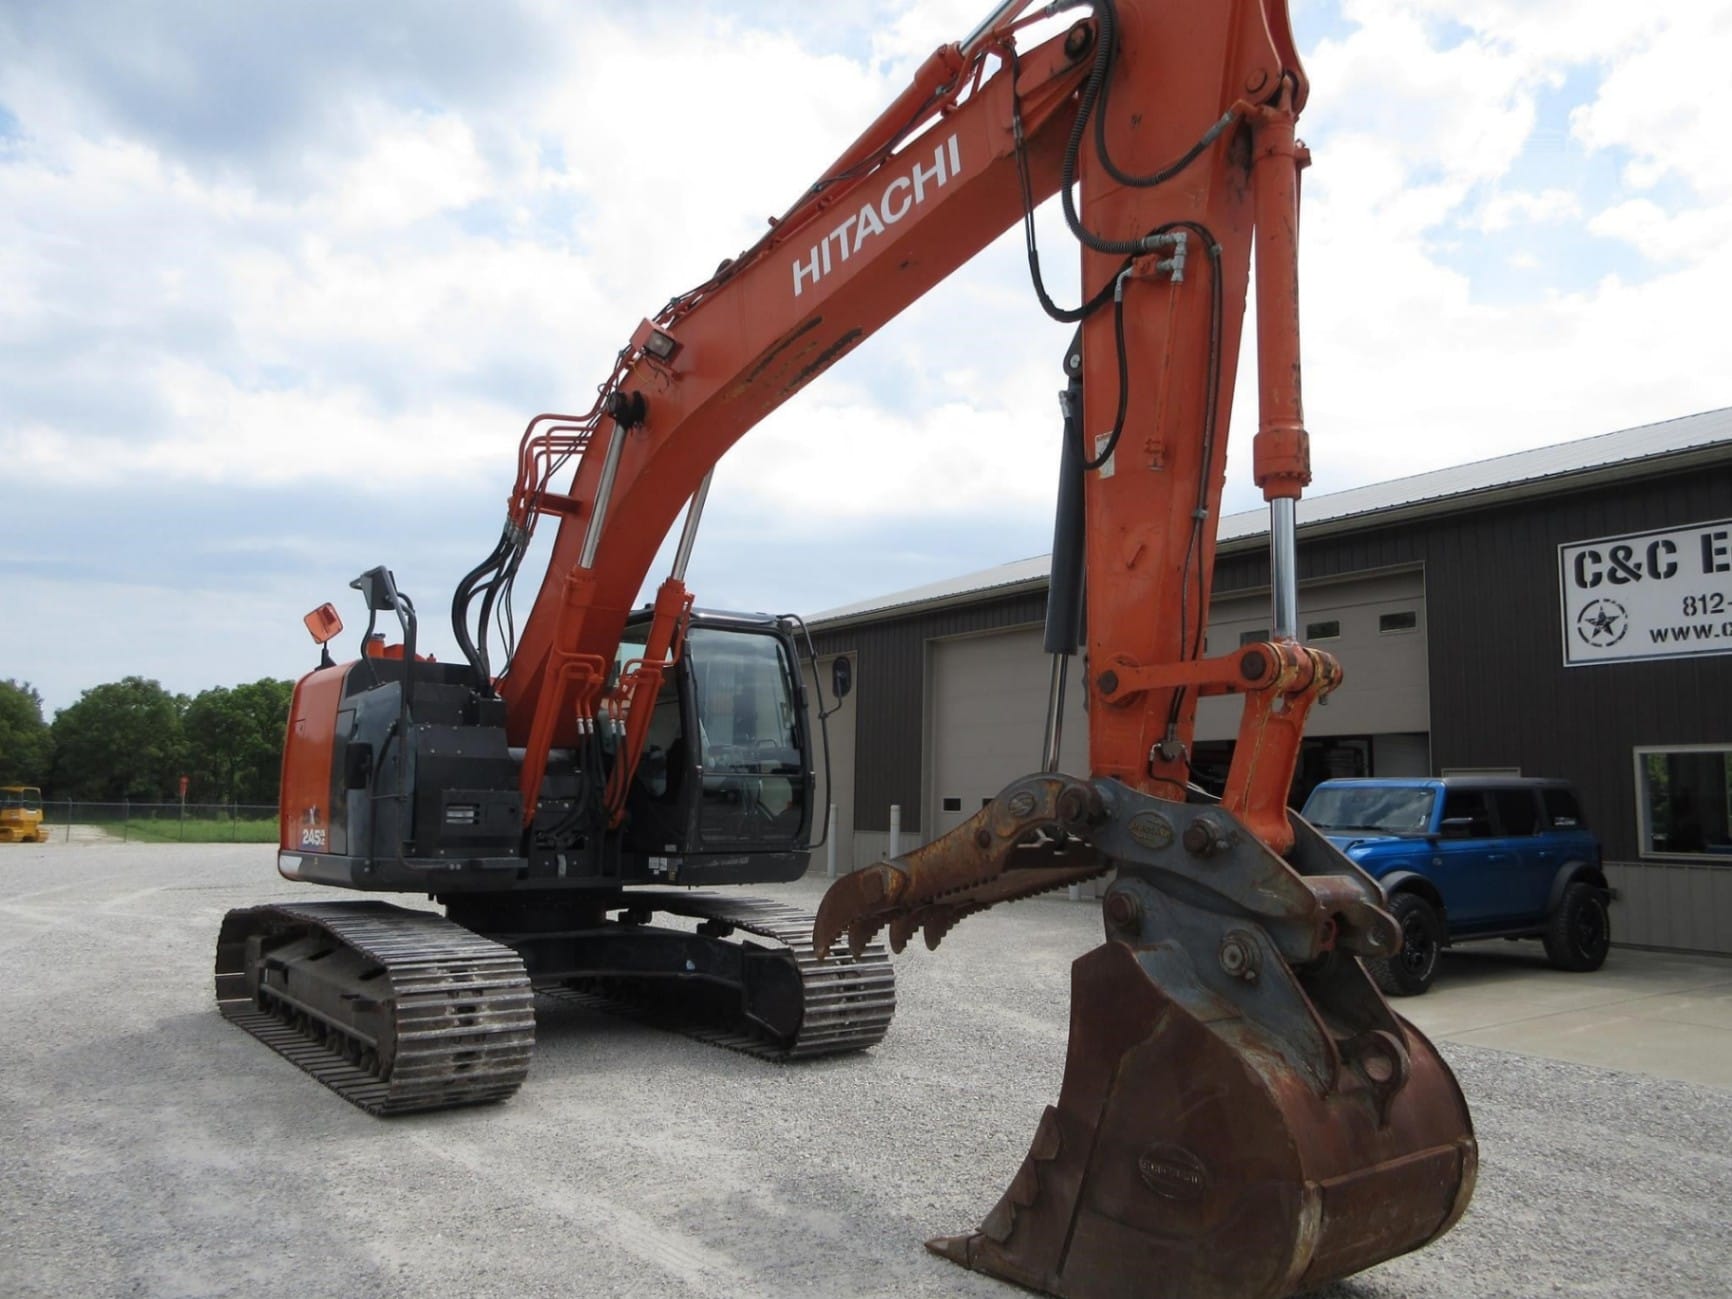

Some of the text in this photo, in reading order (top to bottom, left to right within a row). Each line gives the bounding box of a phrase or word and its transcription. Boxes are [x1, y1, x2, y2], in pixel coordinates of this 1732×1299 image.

[792, 133, 961, 297] HITACHI
[1574, 531, 1732, 589] C&C E
